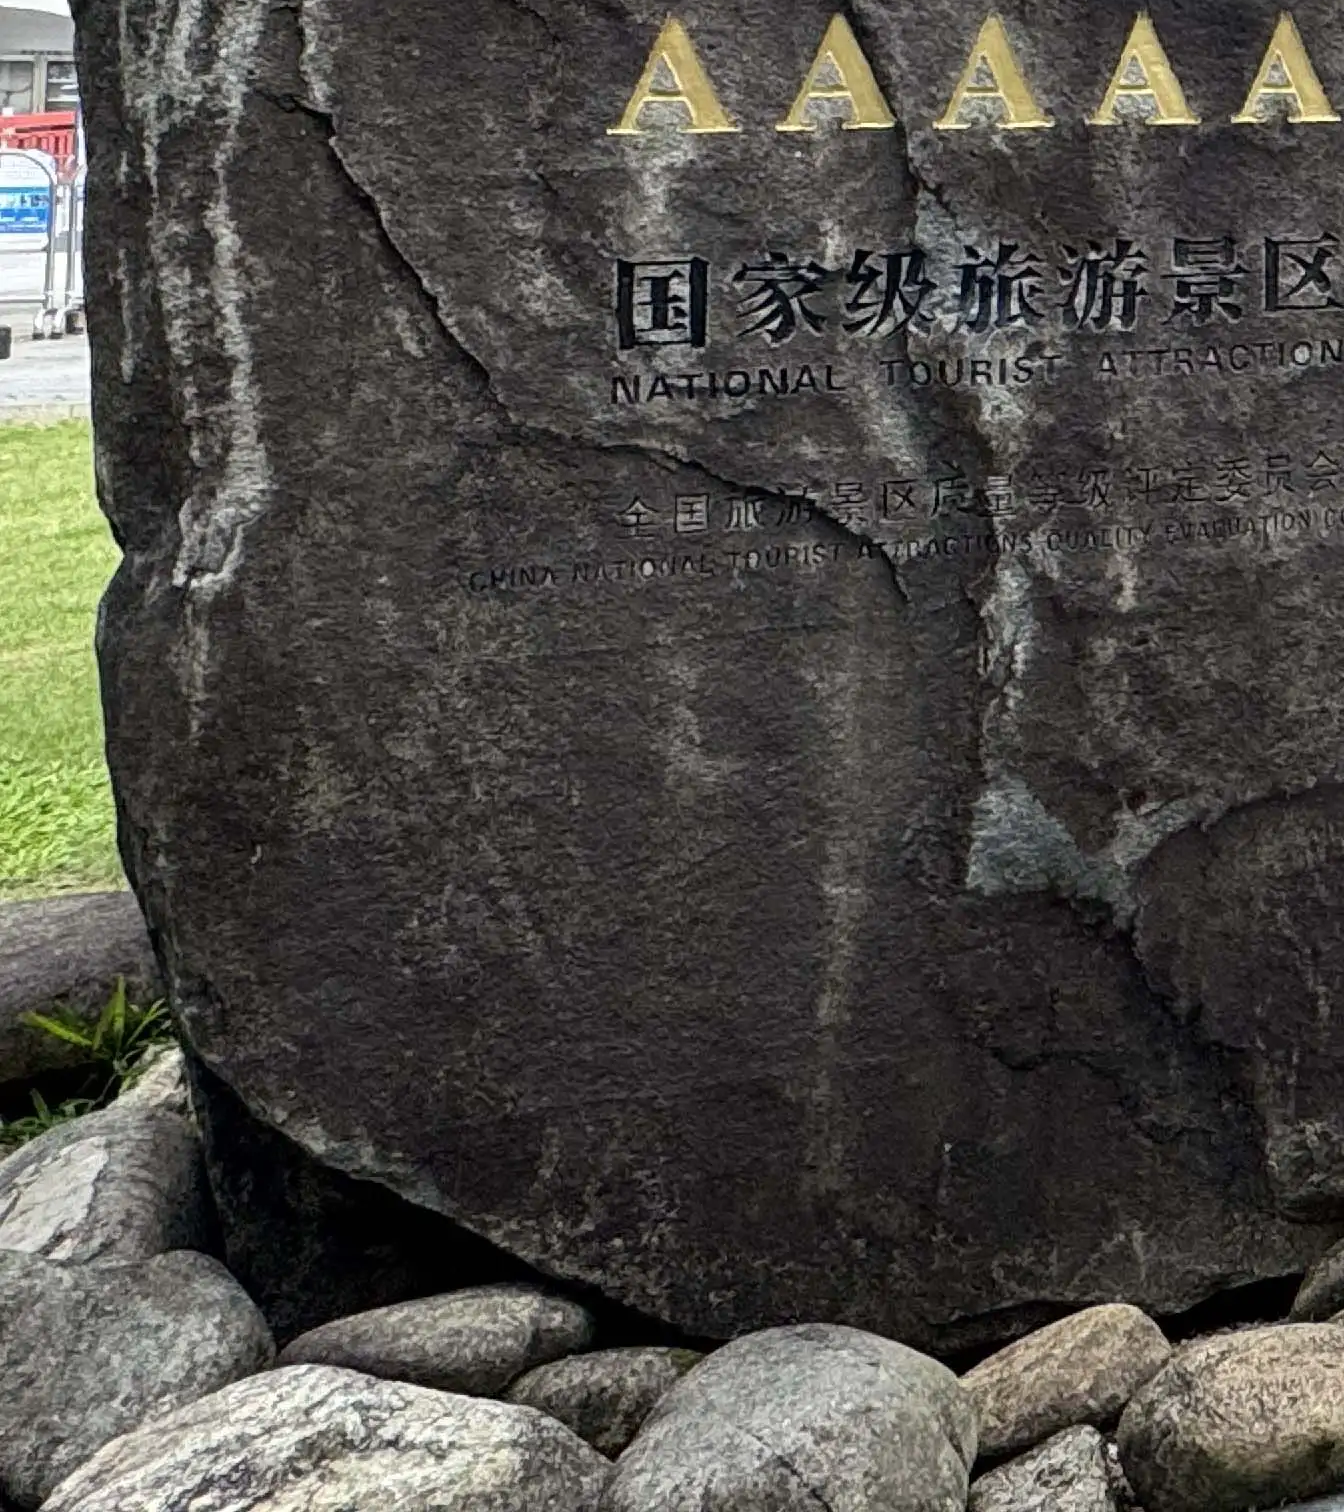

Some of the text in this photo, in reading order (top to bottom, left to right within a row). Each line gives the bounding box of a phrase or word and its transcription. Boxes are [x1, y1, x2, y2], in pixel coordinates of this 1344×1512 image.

[611, 338, 1344, 404] NATIONAL TOURIST ATTRACTION
[468, 563, 559, 592] CHINA
[571, 553, 715, 583] NATIONAL
[726, 542, 842, 571] TOURIST
